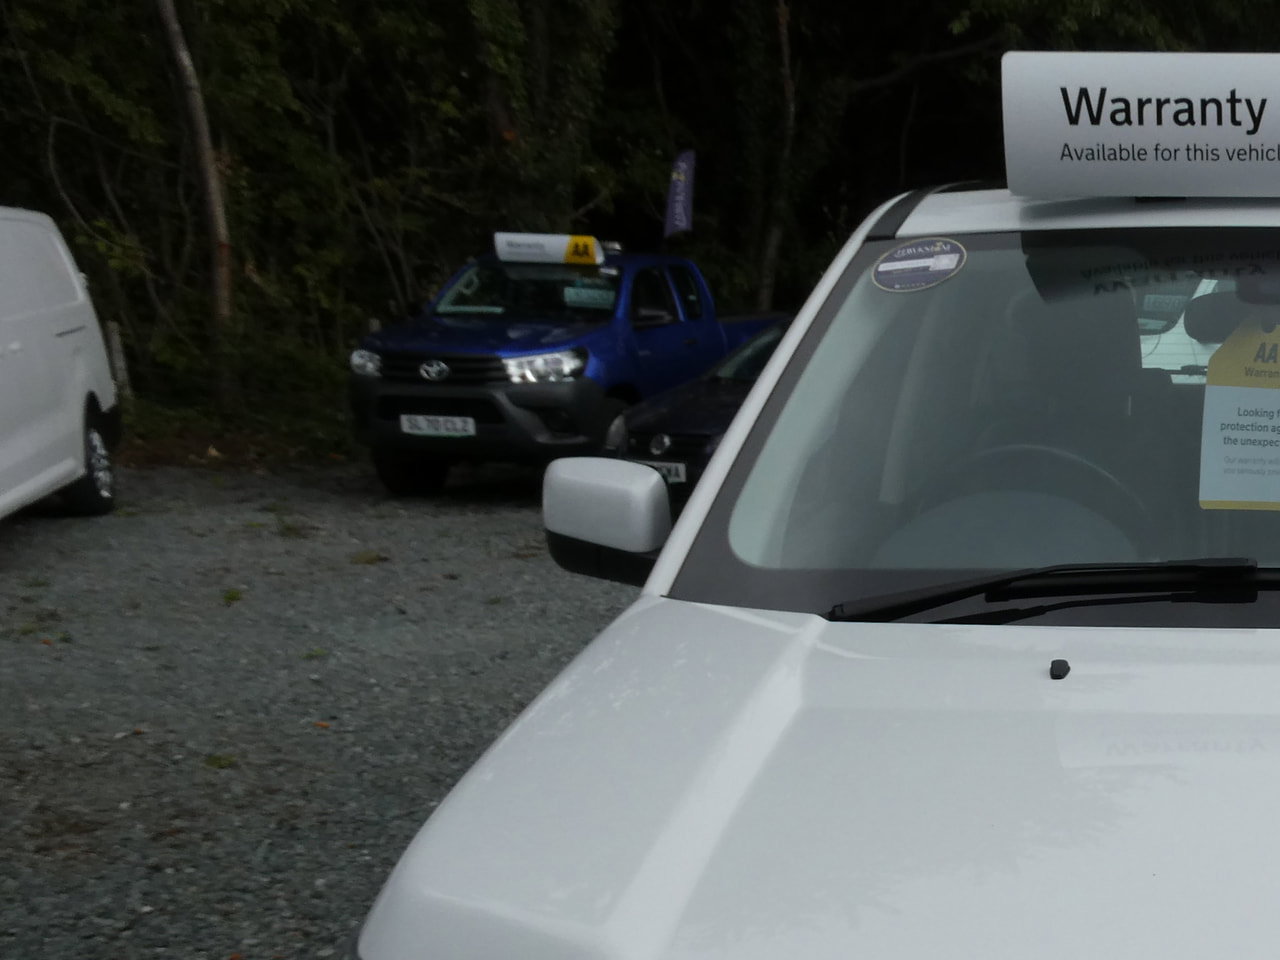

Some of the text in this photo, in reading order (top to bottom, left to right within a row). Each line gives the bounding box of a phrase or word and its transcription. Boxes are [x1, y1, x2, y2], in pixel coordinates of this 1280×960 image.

[1060, 86, 1267, 136] Warranty
[1060, 142, 1149, 163] Available
[1153, 142, 1182, 163] for
[1186, 143, 1220, 163] this
[1253, 342, 1280, 363] AA
[1237, 407, 1275, 420] Looking
[1220, 421, 1269, 433] protection
[1223, 435, 1239, 446] the
